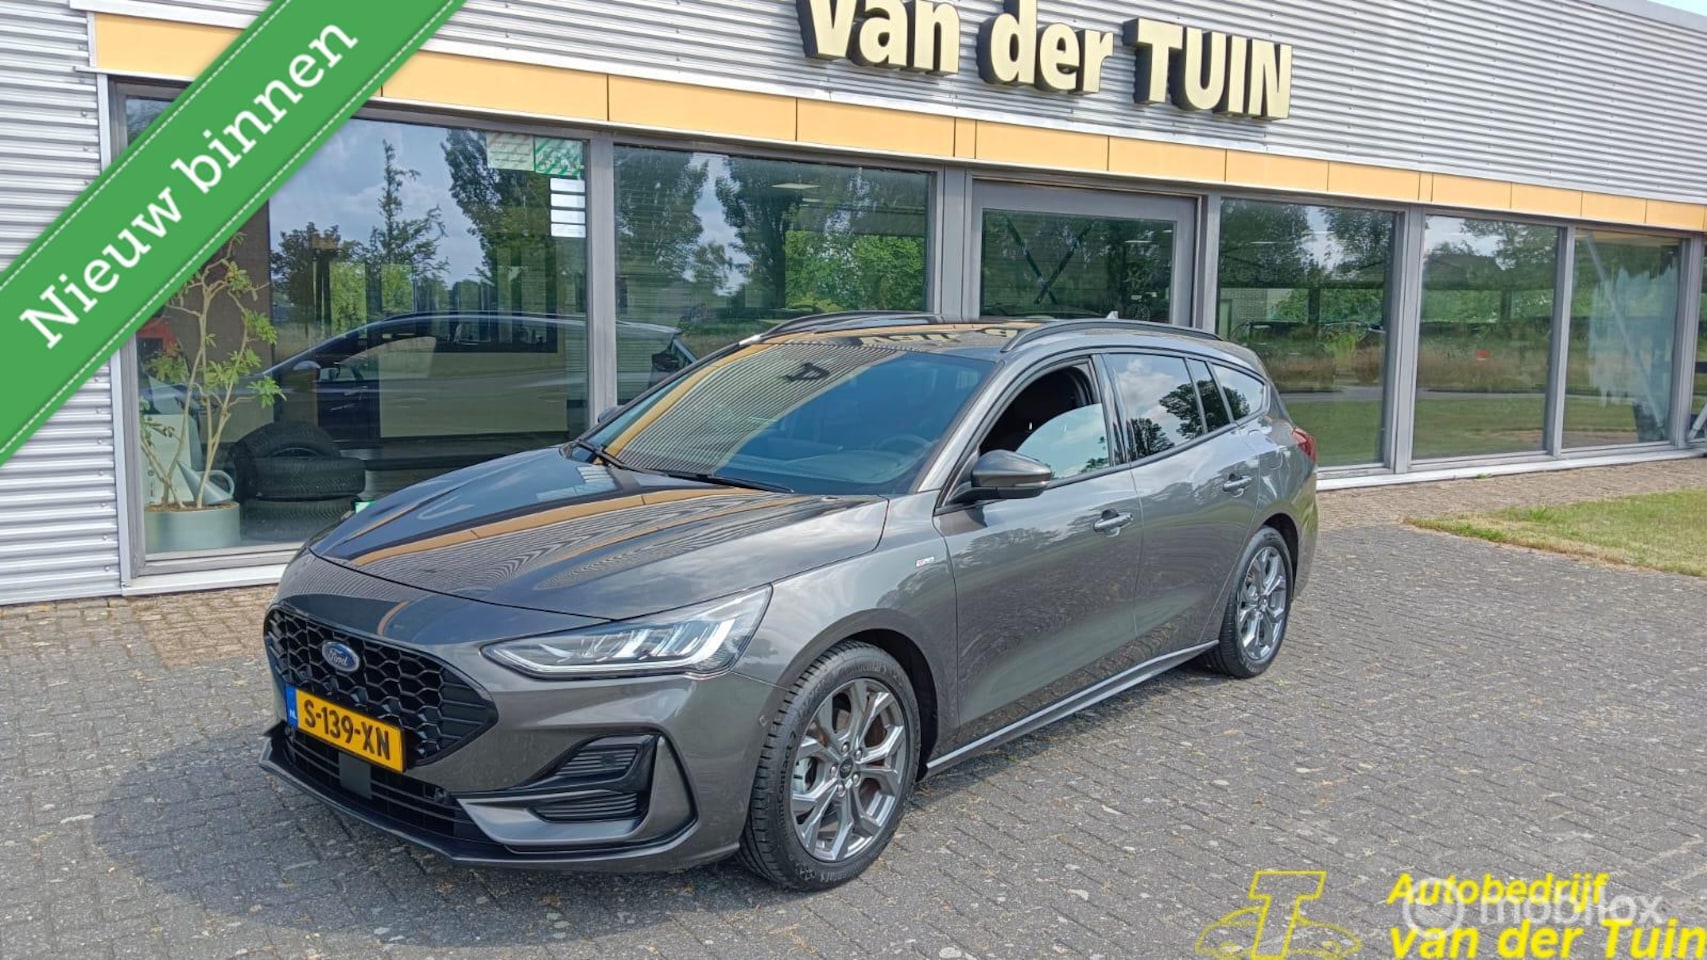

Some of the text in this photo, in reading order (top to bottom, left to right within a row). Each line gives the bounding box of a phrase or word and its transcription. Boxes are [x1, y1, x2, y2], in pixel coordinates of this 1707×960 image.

[979, 0, 1114, 94] der
[1124, 17, 1293, 121] TUIN
[304, 699, 391, 761] S-139-XN
